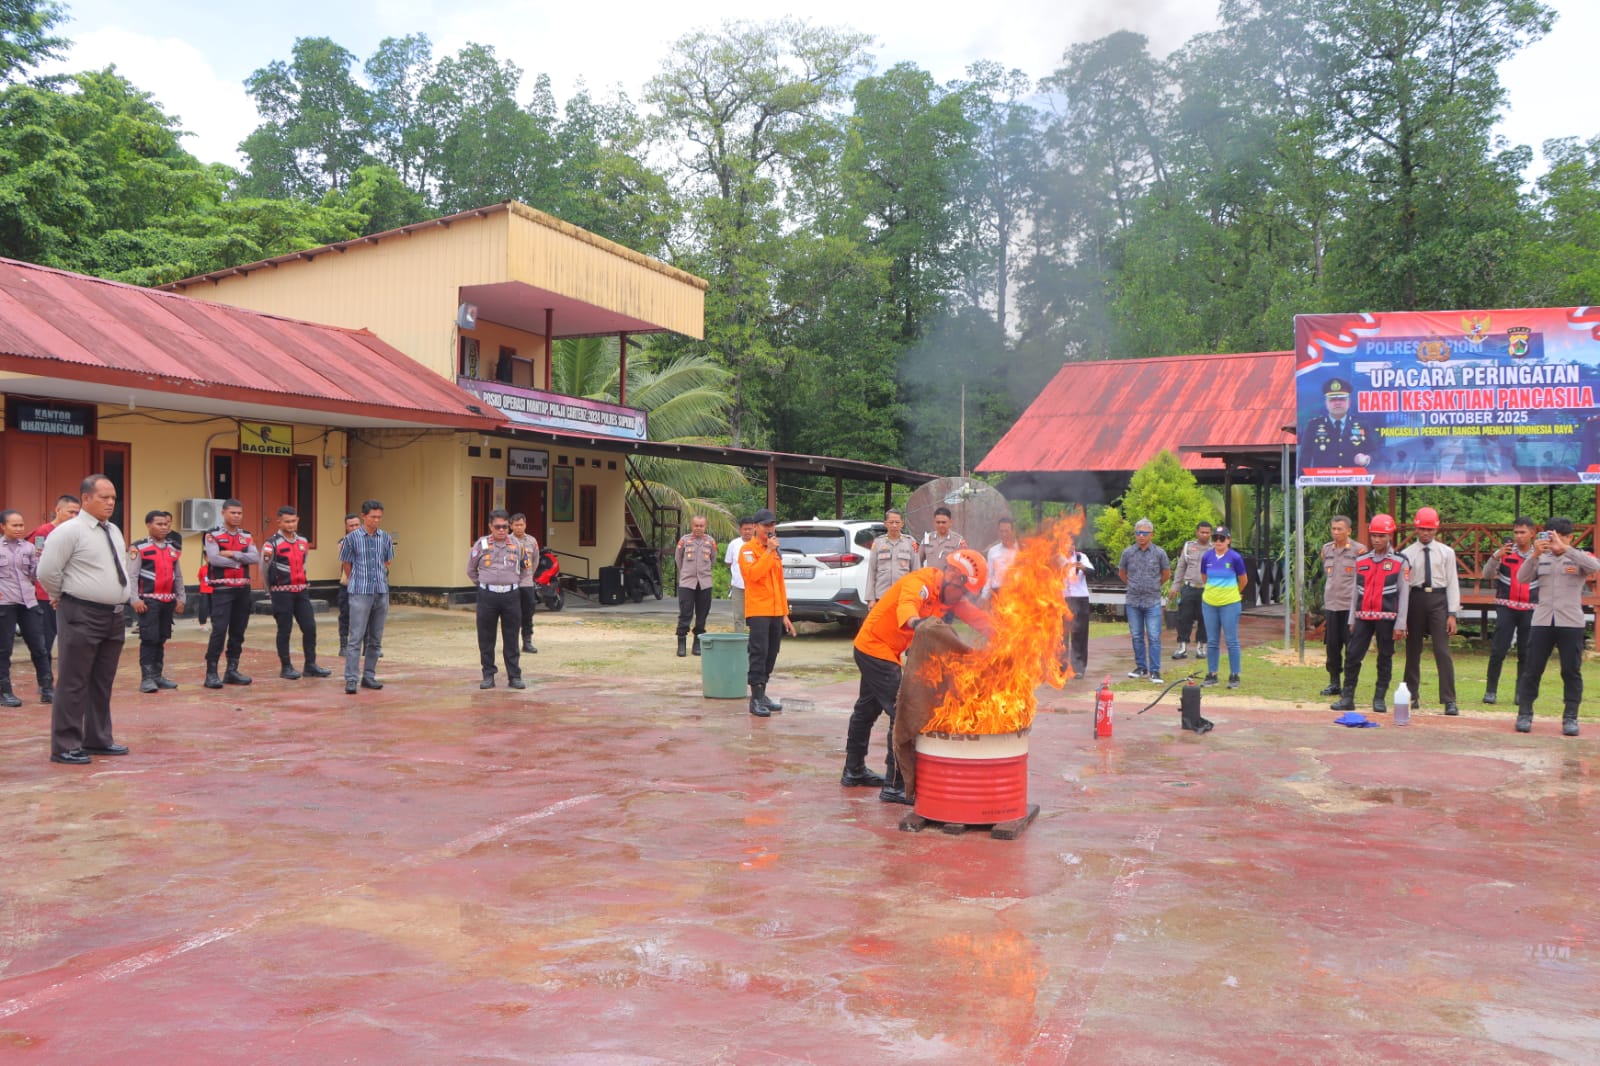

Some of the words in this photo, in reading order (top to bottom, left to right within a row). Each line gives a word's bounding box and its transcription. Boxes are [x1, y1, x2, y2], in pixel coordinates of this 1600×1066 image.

[1366, 340, 1419, 355] POLRES
[1370, 367, 1457, 388] UPACARA
[1462, 364, 1580, 386] PERINGATAN
[1358, 390, 1399, 412] HARI
[1401, 388, 1494, 411] KESAKTIAN
[1497, 386, 1594, 409] PANCASILA
[34, 408, 71, 421] KANTOR
[503, 394, 526, 411] OPERASI
[527, 399, 548, 415] MANTAP
[601, 411, 618, 426] POLRES
[1421, 413, 1426, 424] 1
[1430, 411, 1492, 424] OKTOBER
[1497, 411, 1529, 423] 2025
[20, 420, 84, 436] BHAYANGKARI
[1421, 426, 1450, 436] PEREKAT
[1452, 425, 1480, 436] BANGSA
[1514, 424, 1552, 435] INDONESIA
[242, 443, 290, 454] BAGREN
